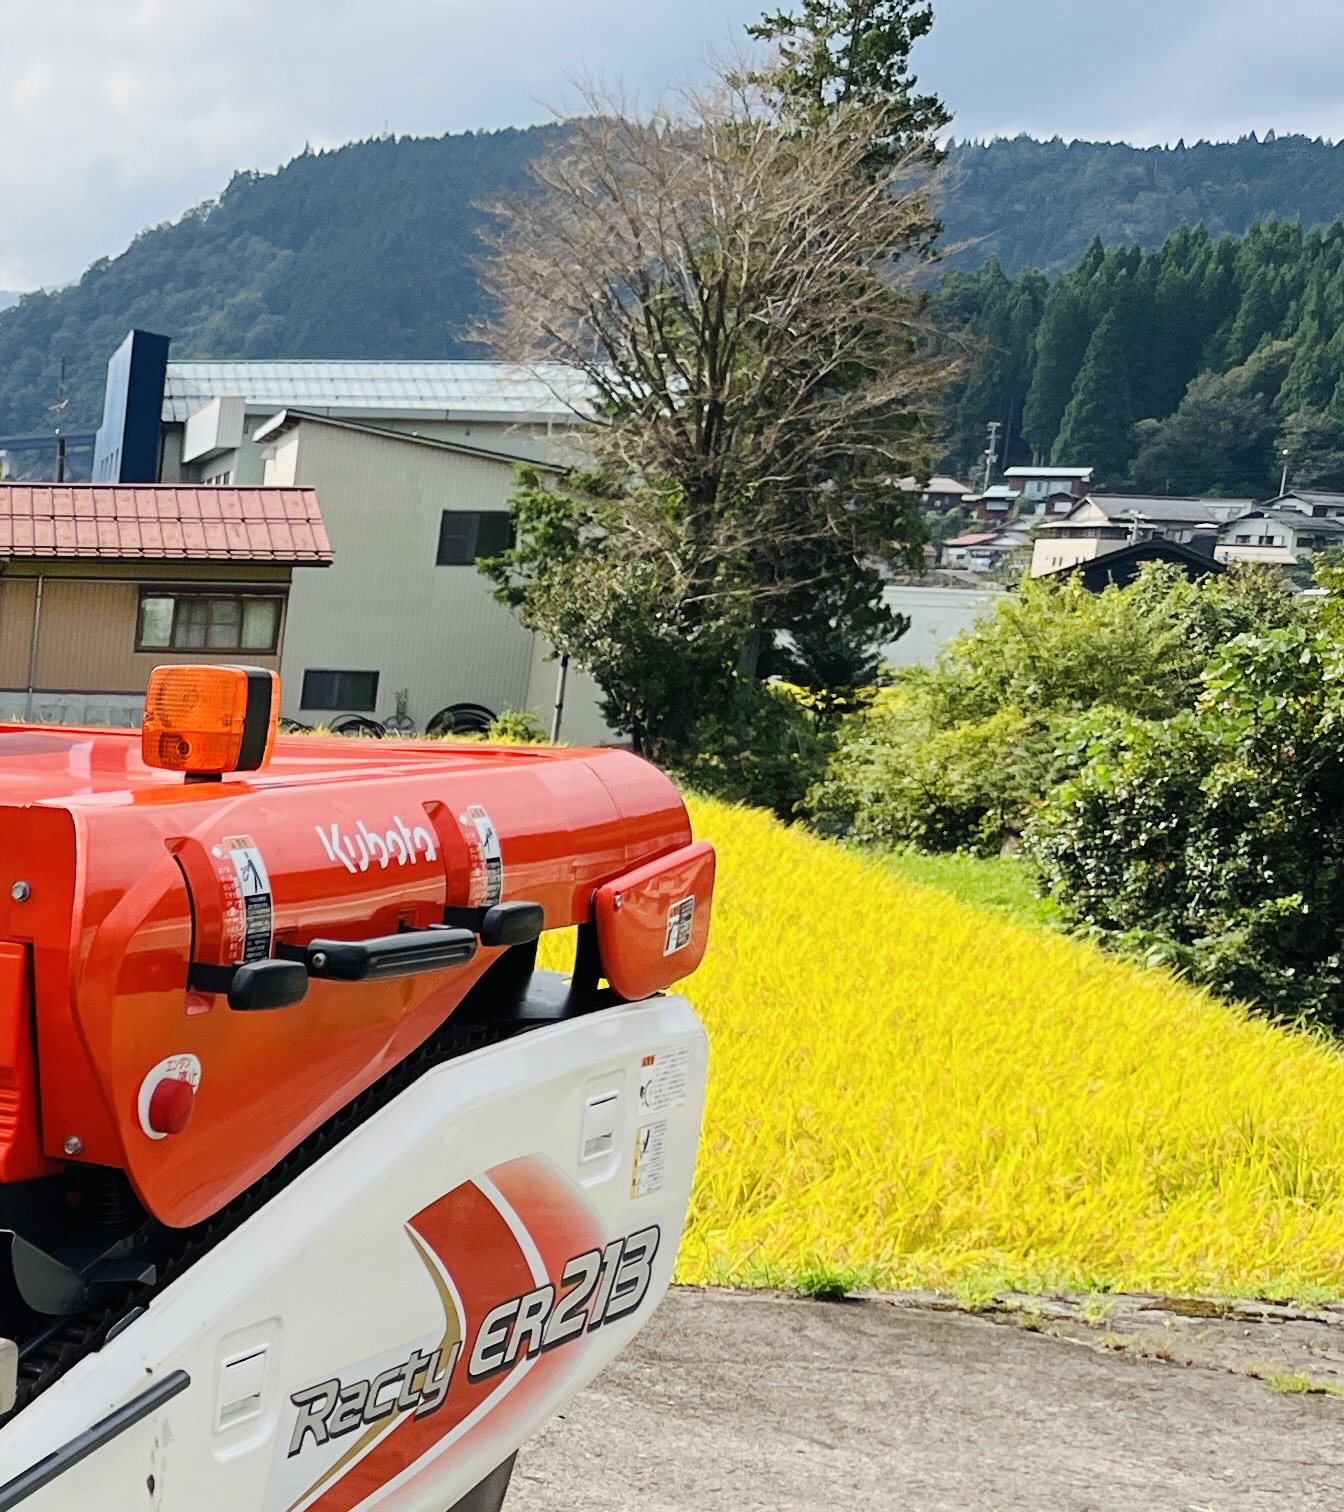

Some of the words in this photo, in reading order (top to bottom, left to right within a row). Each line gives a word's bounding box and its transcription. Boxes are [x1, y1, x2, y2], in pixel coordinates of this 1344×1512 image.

[315, 815, 437, 874] Kubota
[286, 1340, 462, 1459] Racty
[467, 1224, 661, 1384] ER213
